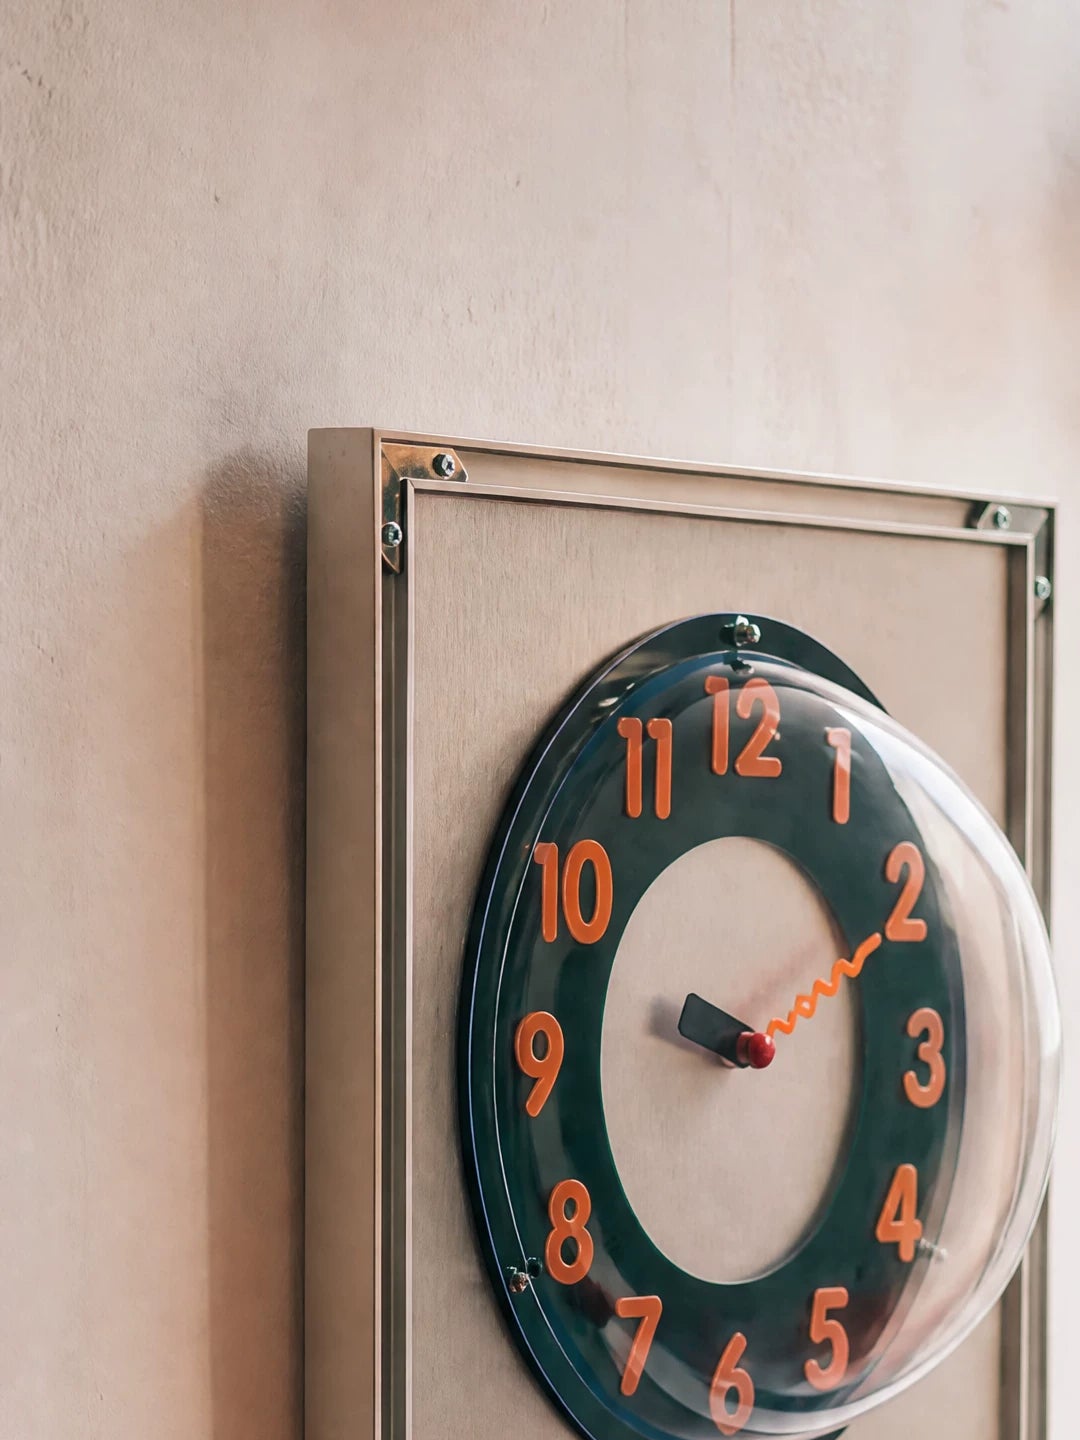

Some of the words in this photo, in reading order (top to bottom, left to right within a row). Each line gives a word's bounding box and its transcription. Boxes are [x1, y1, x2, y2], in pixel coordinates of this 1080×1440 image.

[617, 717, 673, 819] 11
[704, 675, 782, 778] 12
[826, 727, 852, 825] 1
[534, 839, 613, 944] 10
[885, 840, 927, 942] 2
[514, 1010, 564, 1117] 9
[903, 1007, 946, 1108] 3
[545, 1179, 594, 1285] 8
[875, 1163, 923, 1263] 4
[615, 1295, 662, 1396] 7
[709, 1332, 755, 1436] 6
[805, 1286, 849, 1391] 5
